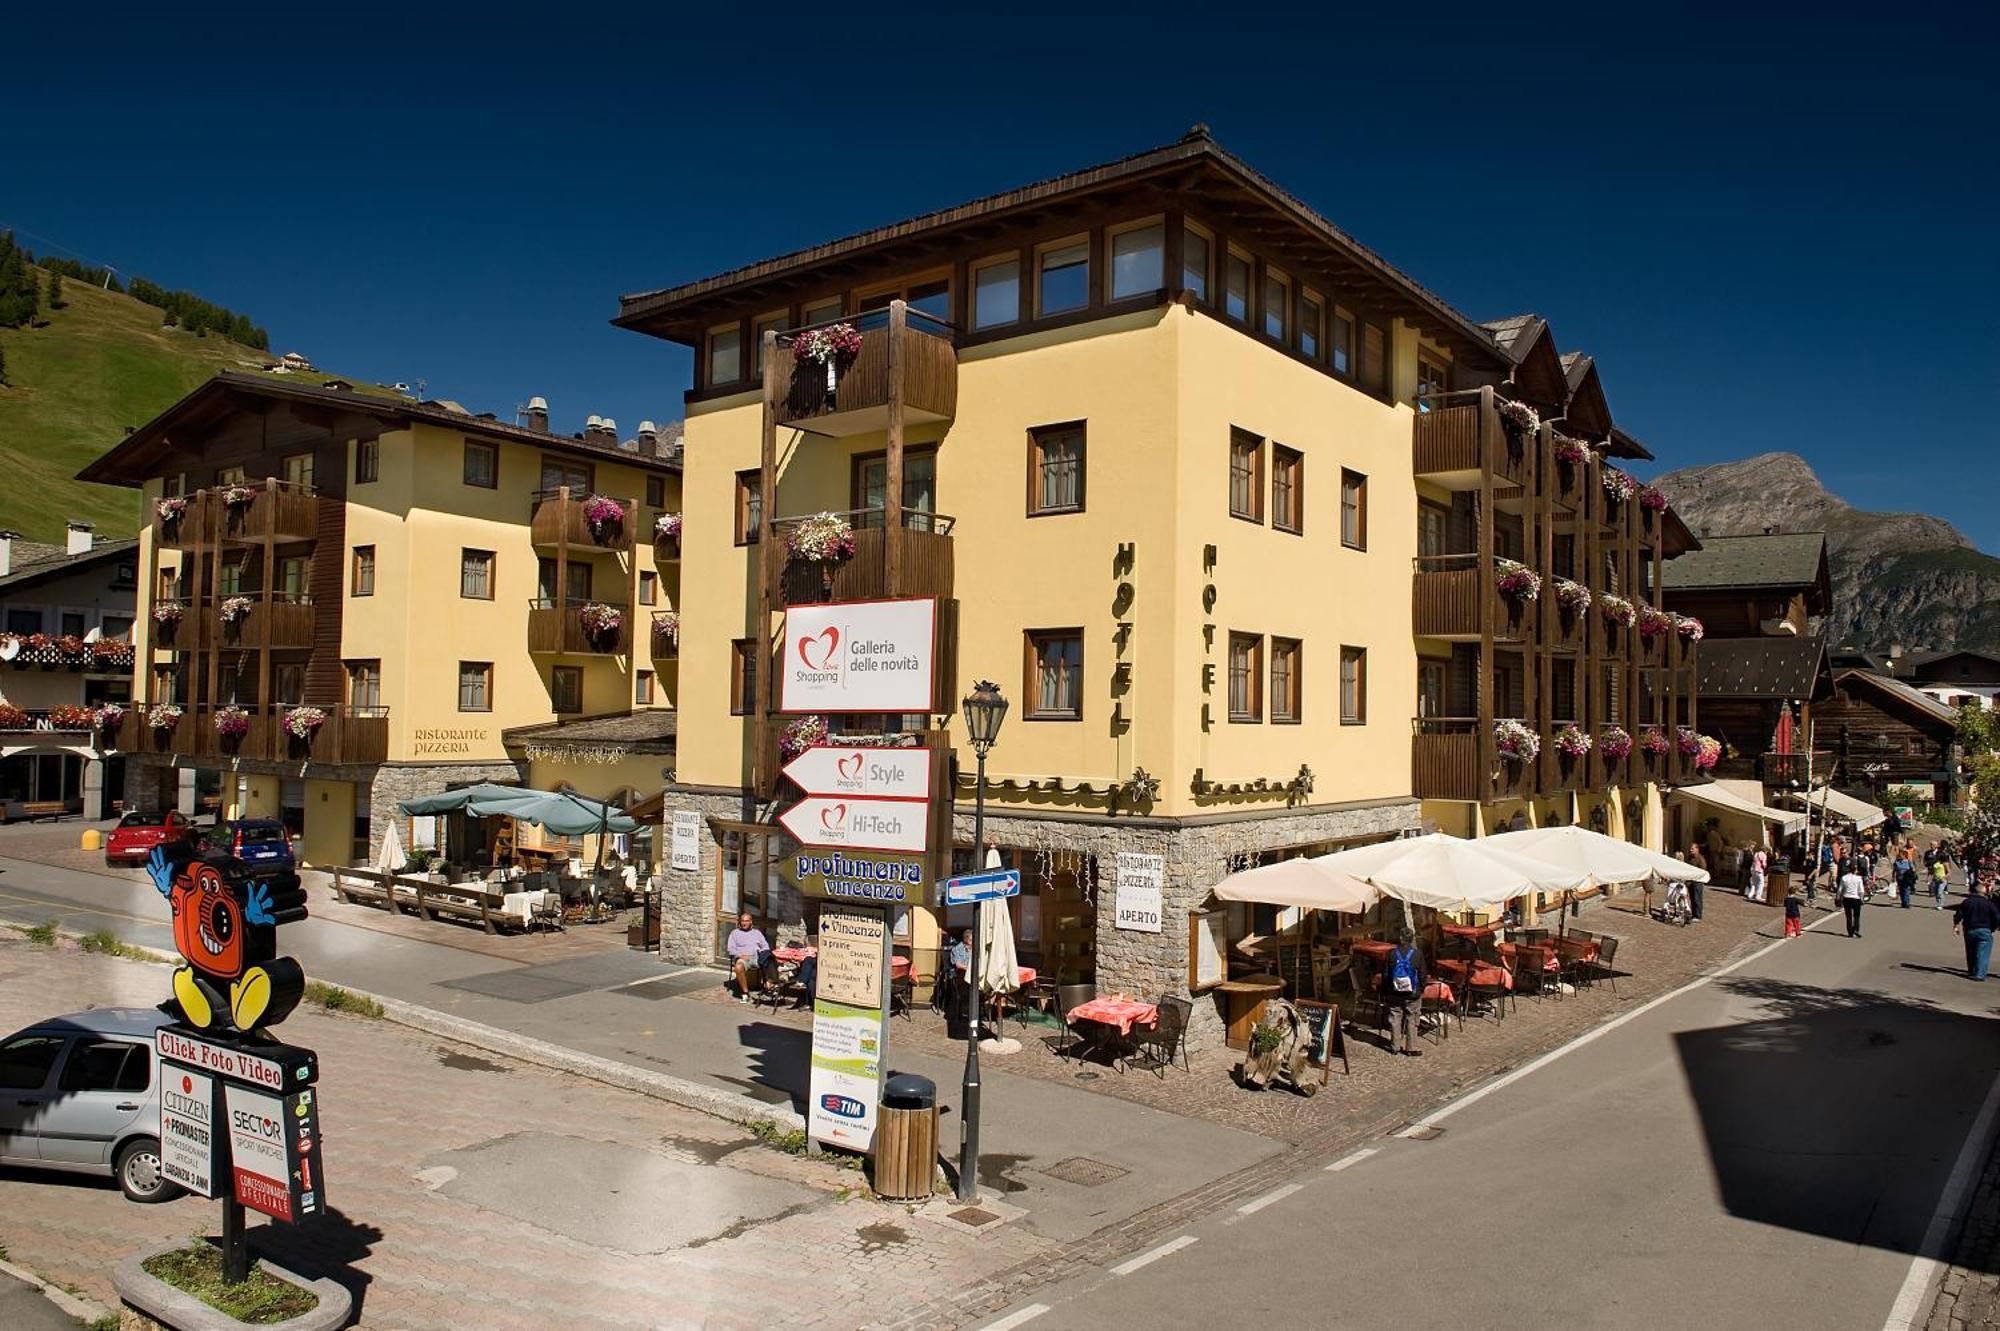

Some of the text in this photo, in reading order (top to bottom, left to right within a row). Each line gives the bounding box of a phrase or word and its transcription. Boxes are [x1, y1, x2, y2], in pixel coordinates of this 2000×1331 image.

[1113, 543, 1135, 730] HOTEL
[1202, 544, 1217, 730] HOTEL
[851, 640, 895, 655] Galleria
[850, 655, 918, 671] delle novità
[796, 671, 838, 683] Shopping
[414, 742, 469, 756] PIZZERIA
[871, 764, 905, 785] Style
[853, 816, 902, 835] Hi-Tech
[797, 852, 922, 884] profumeria
[824, 879, 905, 901] vincenzo
[821, 906, 883, 925] Profumeria
[1120, 909, 1157, 924] APERTO
[831, 921, 882, 938] Vincenzo
[160, 1033, 196, 1061] Click
[201, 1044, 233, 1072] Foto
[237, 1055, 281, 1086] Video
[164, 1090, 210, 1121] CITIZEN
[841, 1100, 861, 1116] TIM
[171, 1118, 210, 1146] PROMASTER
[233, 1110, 282, 1140] SECTOR
[240, 1174, 288, 1201] CONCESSIONARIO
[241, 1186, 289, 1213] UFFICIALE
